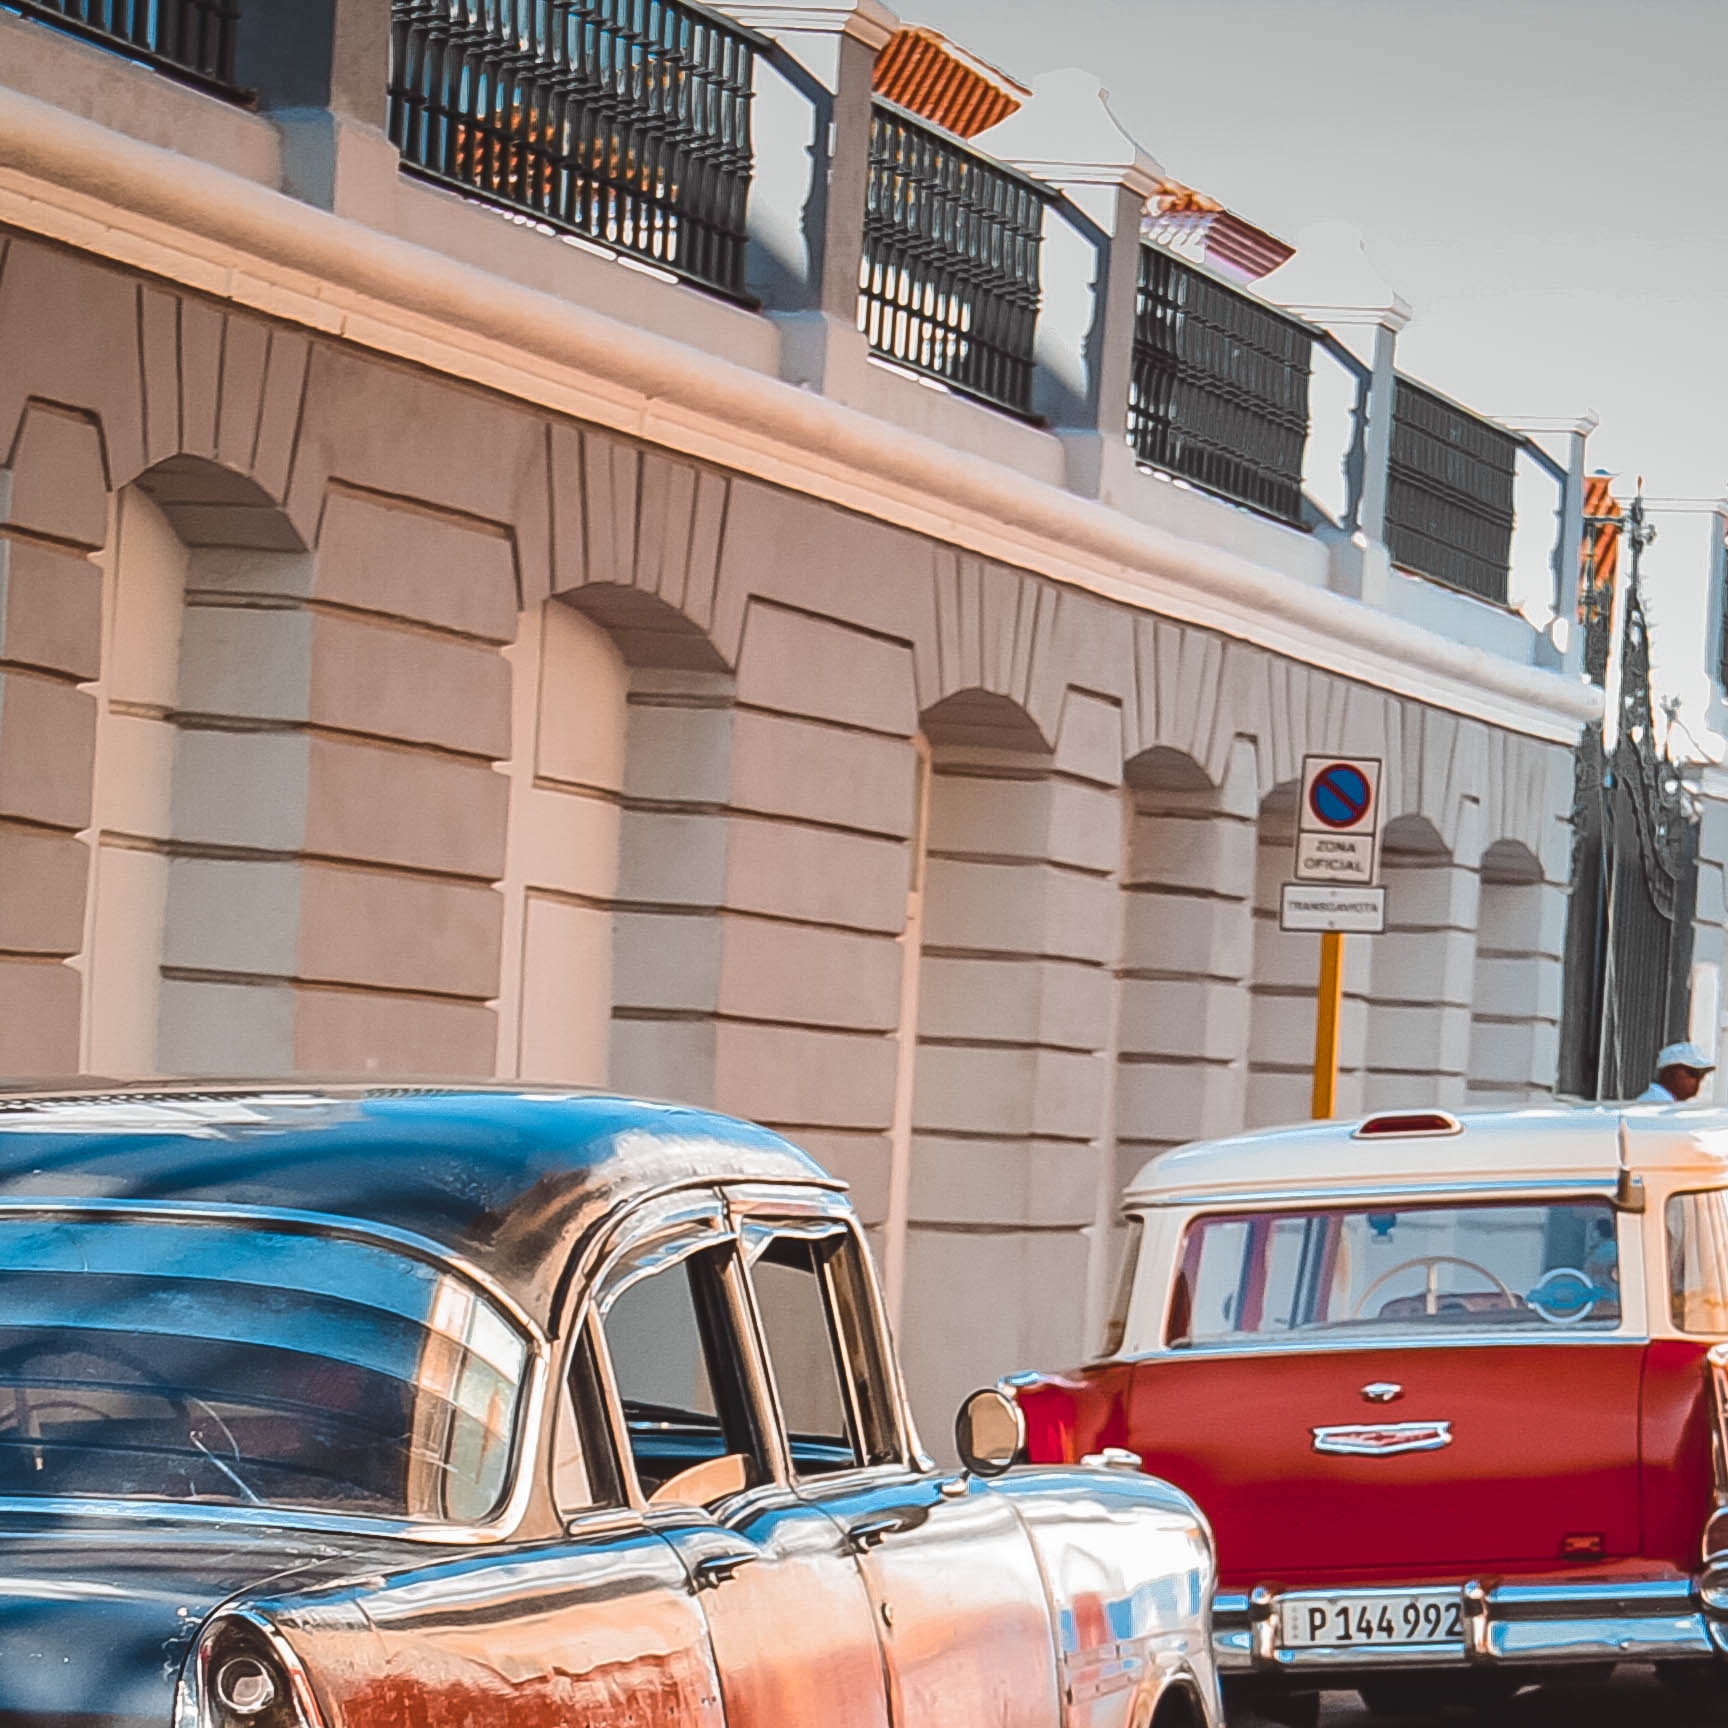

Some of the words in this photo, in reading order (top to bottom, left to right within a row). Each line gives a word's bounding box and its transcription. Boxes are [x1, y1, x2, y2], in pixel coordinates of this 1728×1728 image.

[1315, 840, 1357, 853] ZONA
[1303, 857, 1364, 873] OFICIAL
[1308, 1606, 1327, 1642] P
[1334, 1605, 1395, 1641] 144
[1402, 1602, 1464, 1639] 992
